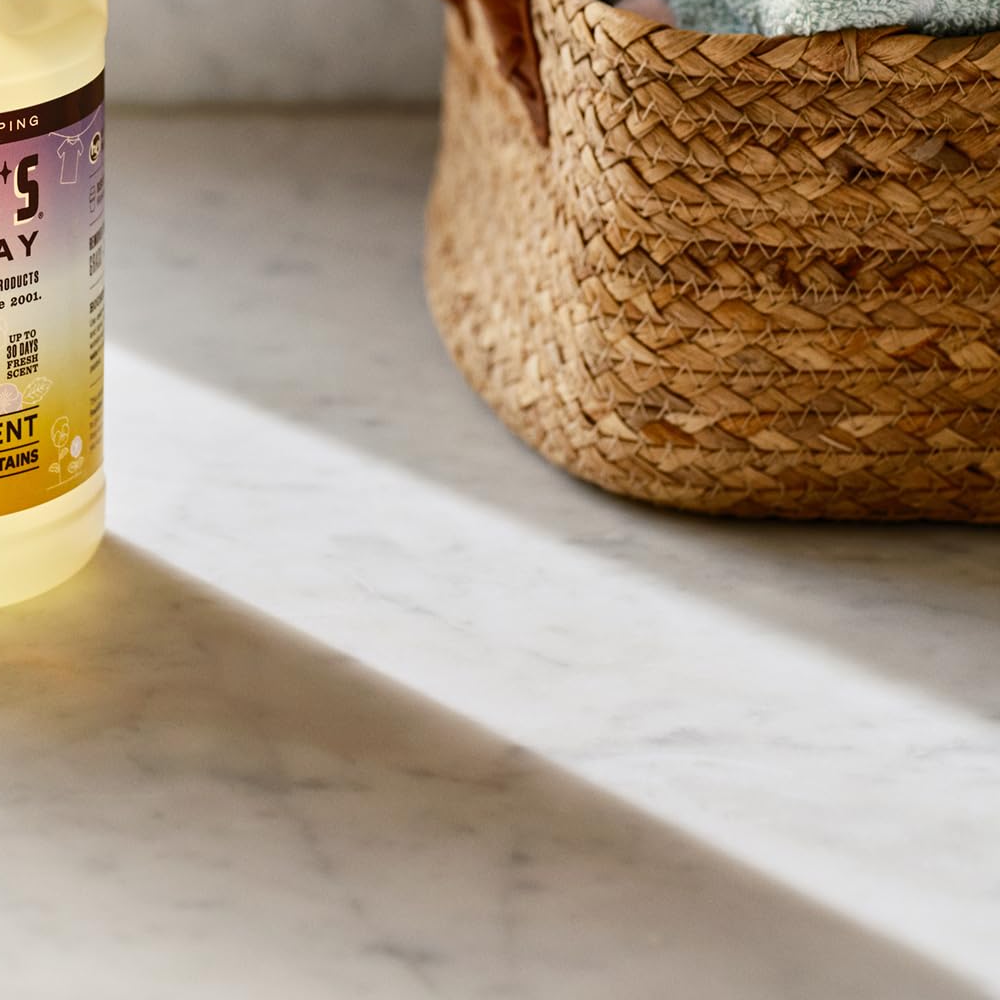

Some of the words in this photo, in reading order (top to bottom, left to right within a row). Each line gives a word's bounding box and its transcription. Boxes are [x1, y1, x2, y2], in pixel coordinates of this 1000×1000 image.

[10, 291, 42, 307] 2001.
[8, 333, 23, 344] UP
[23, 329, 37, 340] TO
[6, 345, 18, 359] 30
[19, 338, 38, 356] DAYS
[6, 353, 39, 370] FRESH
[6, 363, 39, 380] SCENT
